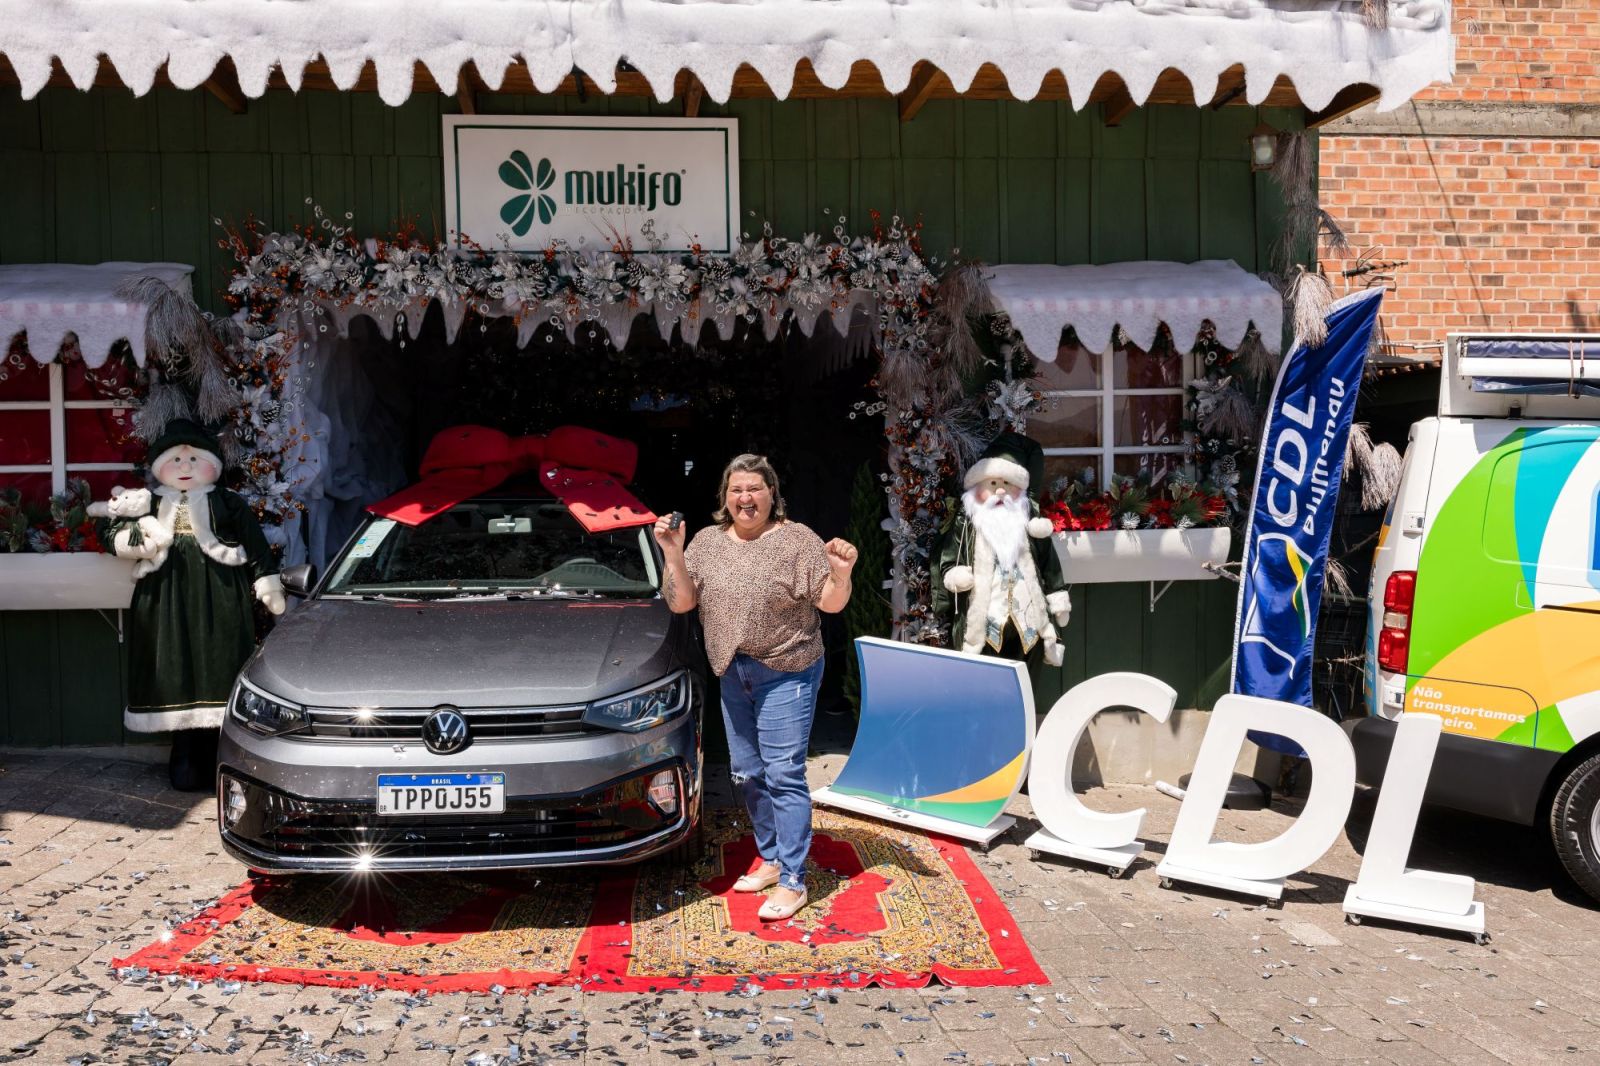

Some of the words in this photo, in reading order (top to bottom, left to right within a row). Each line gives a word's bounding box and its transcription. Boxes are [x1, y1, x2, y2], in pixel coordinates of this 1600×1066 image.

[564, 163, 682, 211] mukifo
[1267, 395, 1316, 527] CDL
[1412, 698, 1527, 724] transportamos
[1413, 686, 1443, 699] Não
[1028, 671, 1476, 916] CDL
